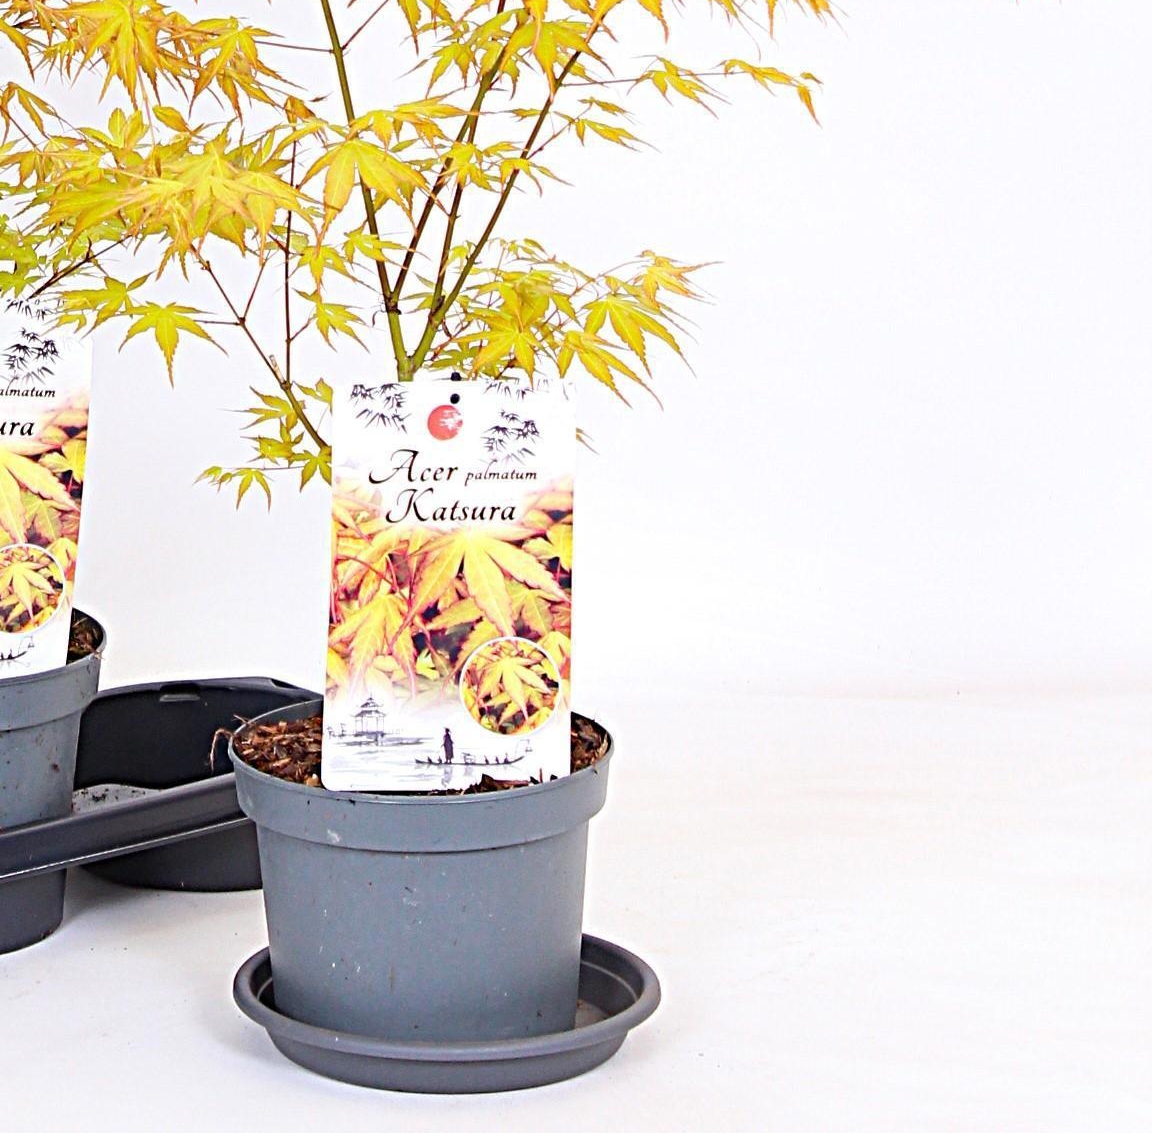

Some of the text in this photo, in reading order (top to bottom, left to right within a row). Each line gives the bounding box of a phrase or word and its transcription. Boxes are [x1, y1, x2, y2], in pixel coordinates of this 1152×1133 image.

[368, 449, 537, 487] Acer palmatum
[385, 487, 516, 524] Katsura
